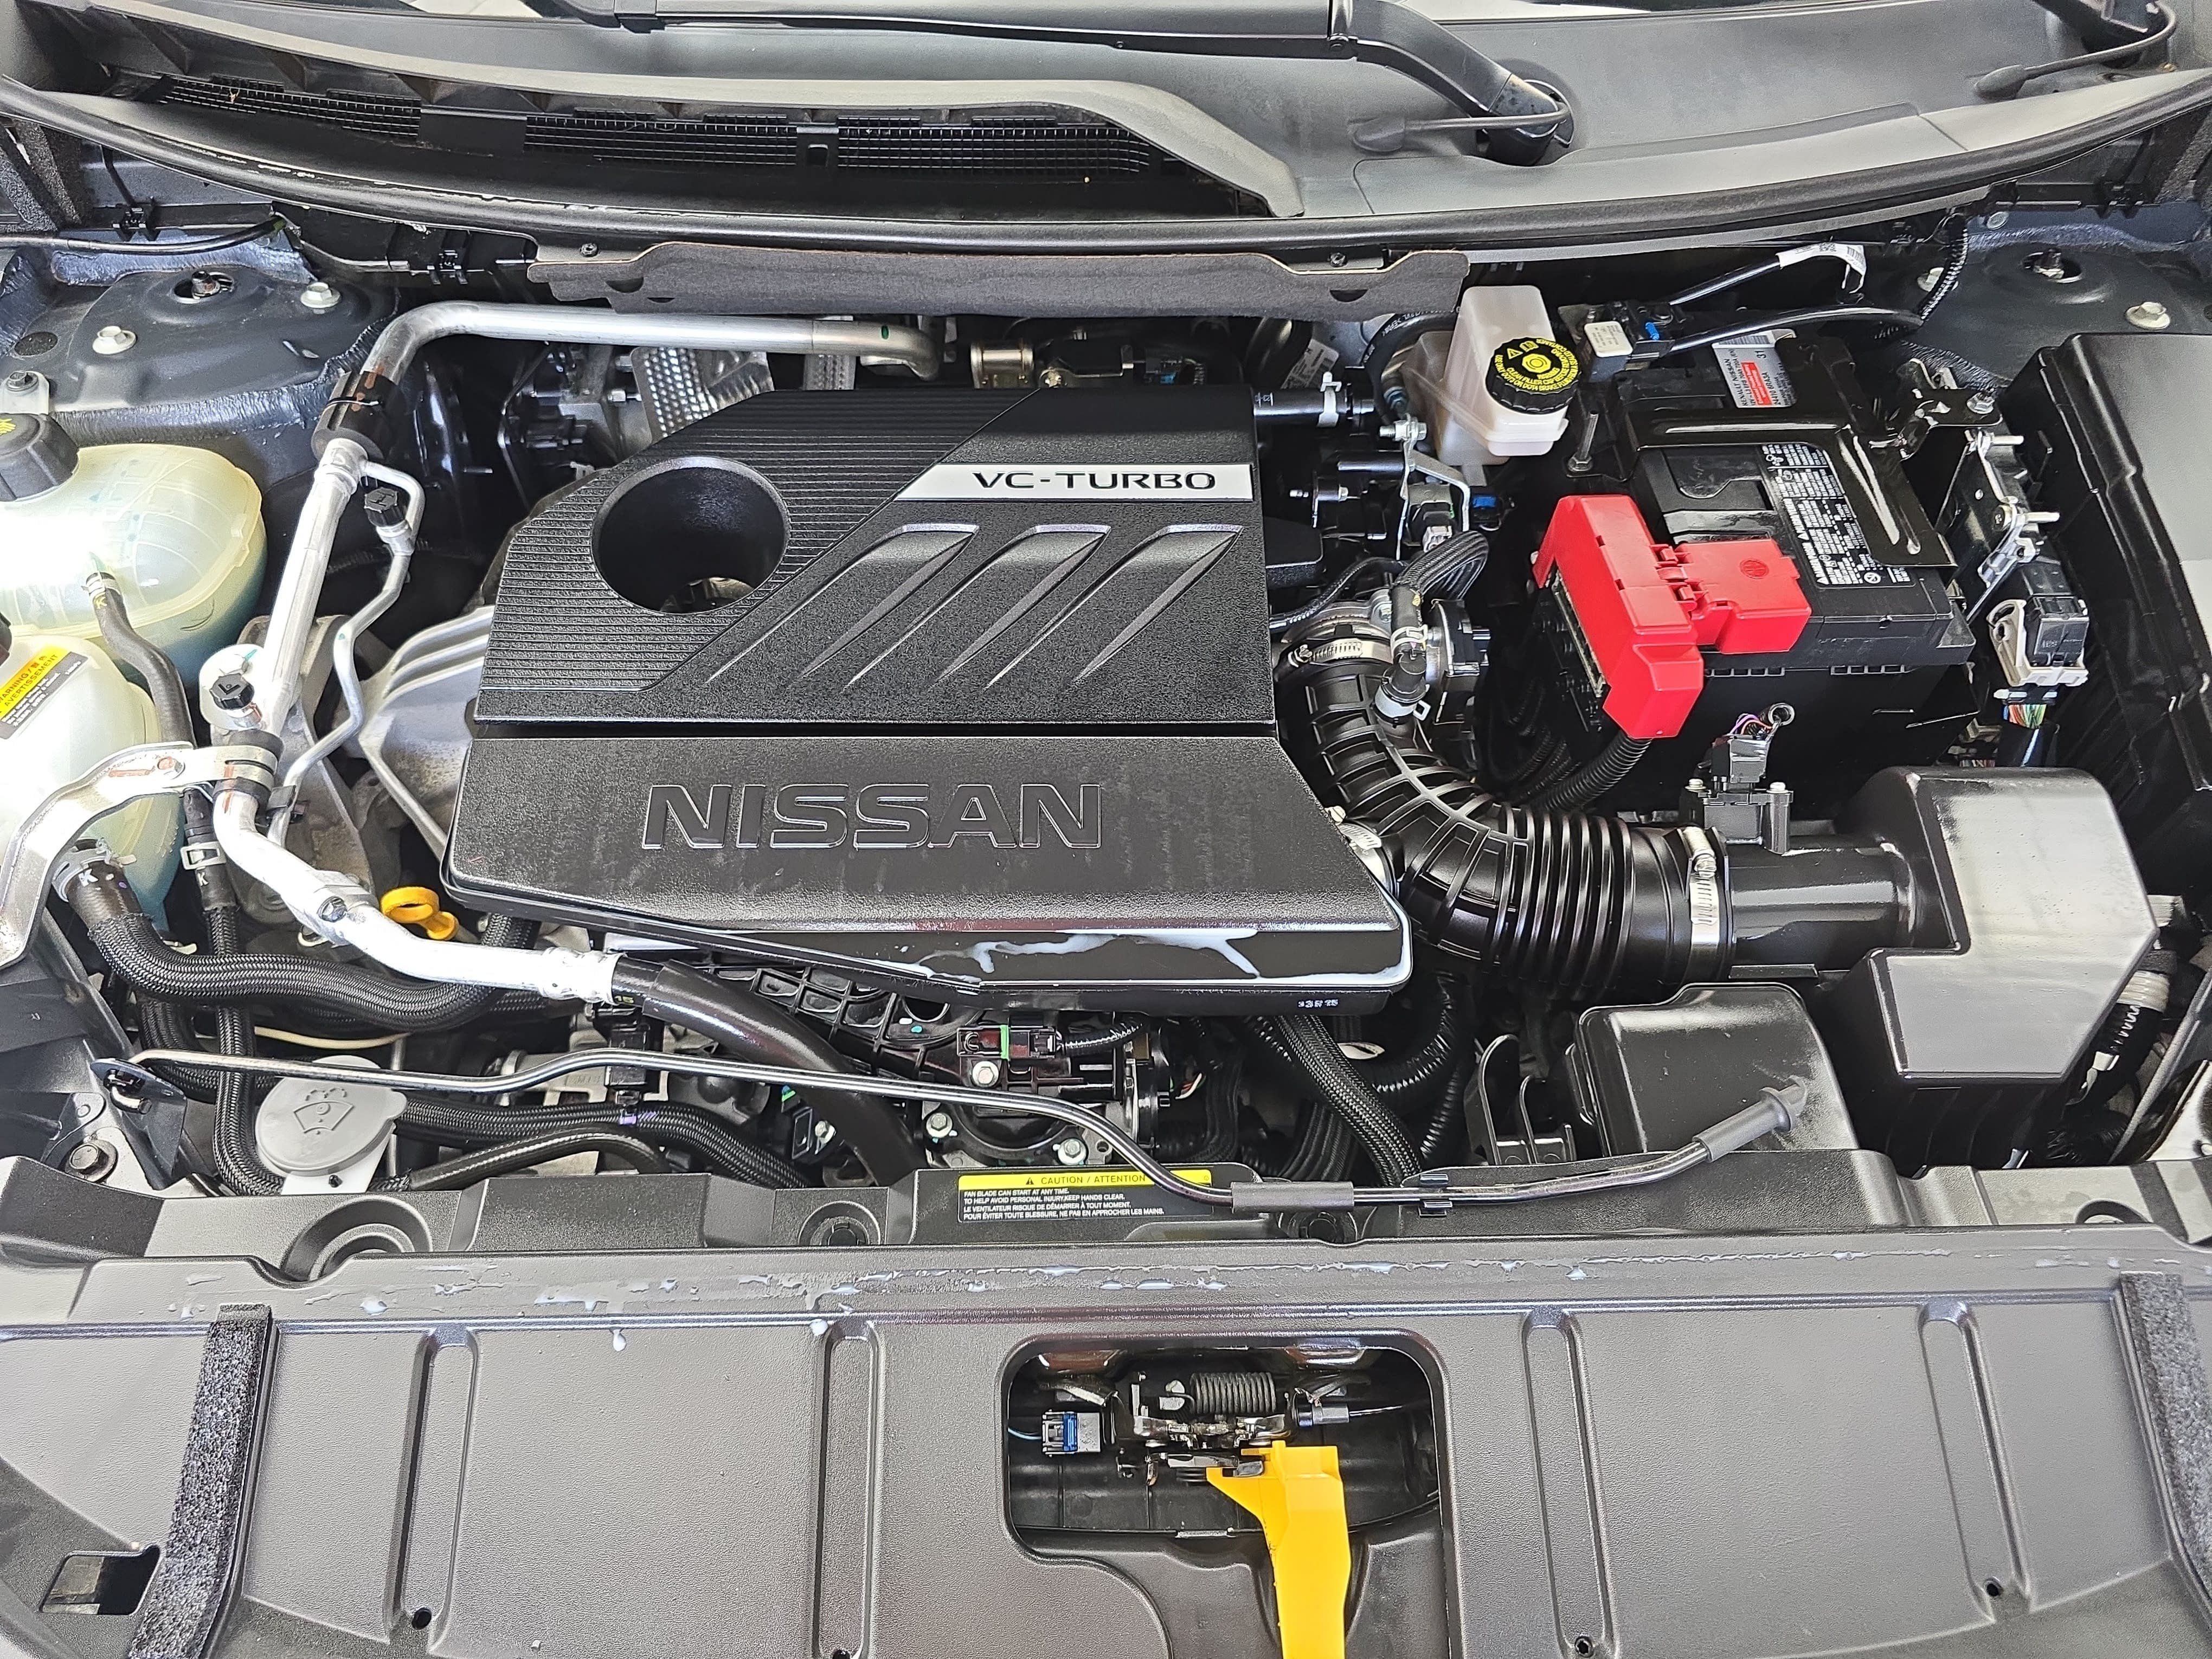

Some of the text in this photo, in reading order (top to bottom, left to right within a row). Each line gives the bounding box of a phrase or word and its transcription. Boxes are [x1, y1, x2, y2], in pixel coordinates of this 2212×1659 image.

[1507, 368, 1522, 381] CLEAN
[1723, 358, 1738, 381] NISSAN
[972, 471, 1216, 490] VC-TURBO
[95, 596, 108, 609] K
[5, 654, 58, 706] AVERTISSEMENT
[218, 683, 241, 695] L
[641, 782, 1102, 850] NISSAN
[78, 869, 99, 886] K
[197, 872, 209, 886] K
[1041, 1176, 1083, 1184] CAUTION
[1094, 1175, 1146, 1183] ATTENTION
[982, 1211, 1003, 1220] ÉVITER
